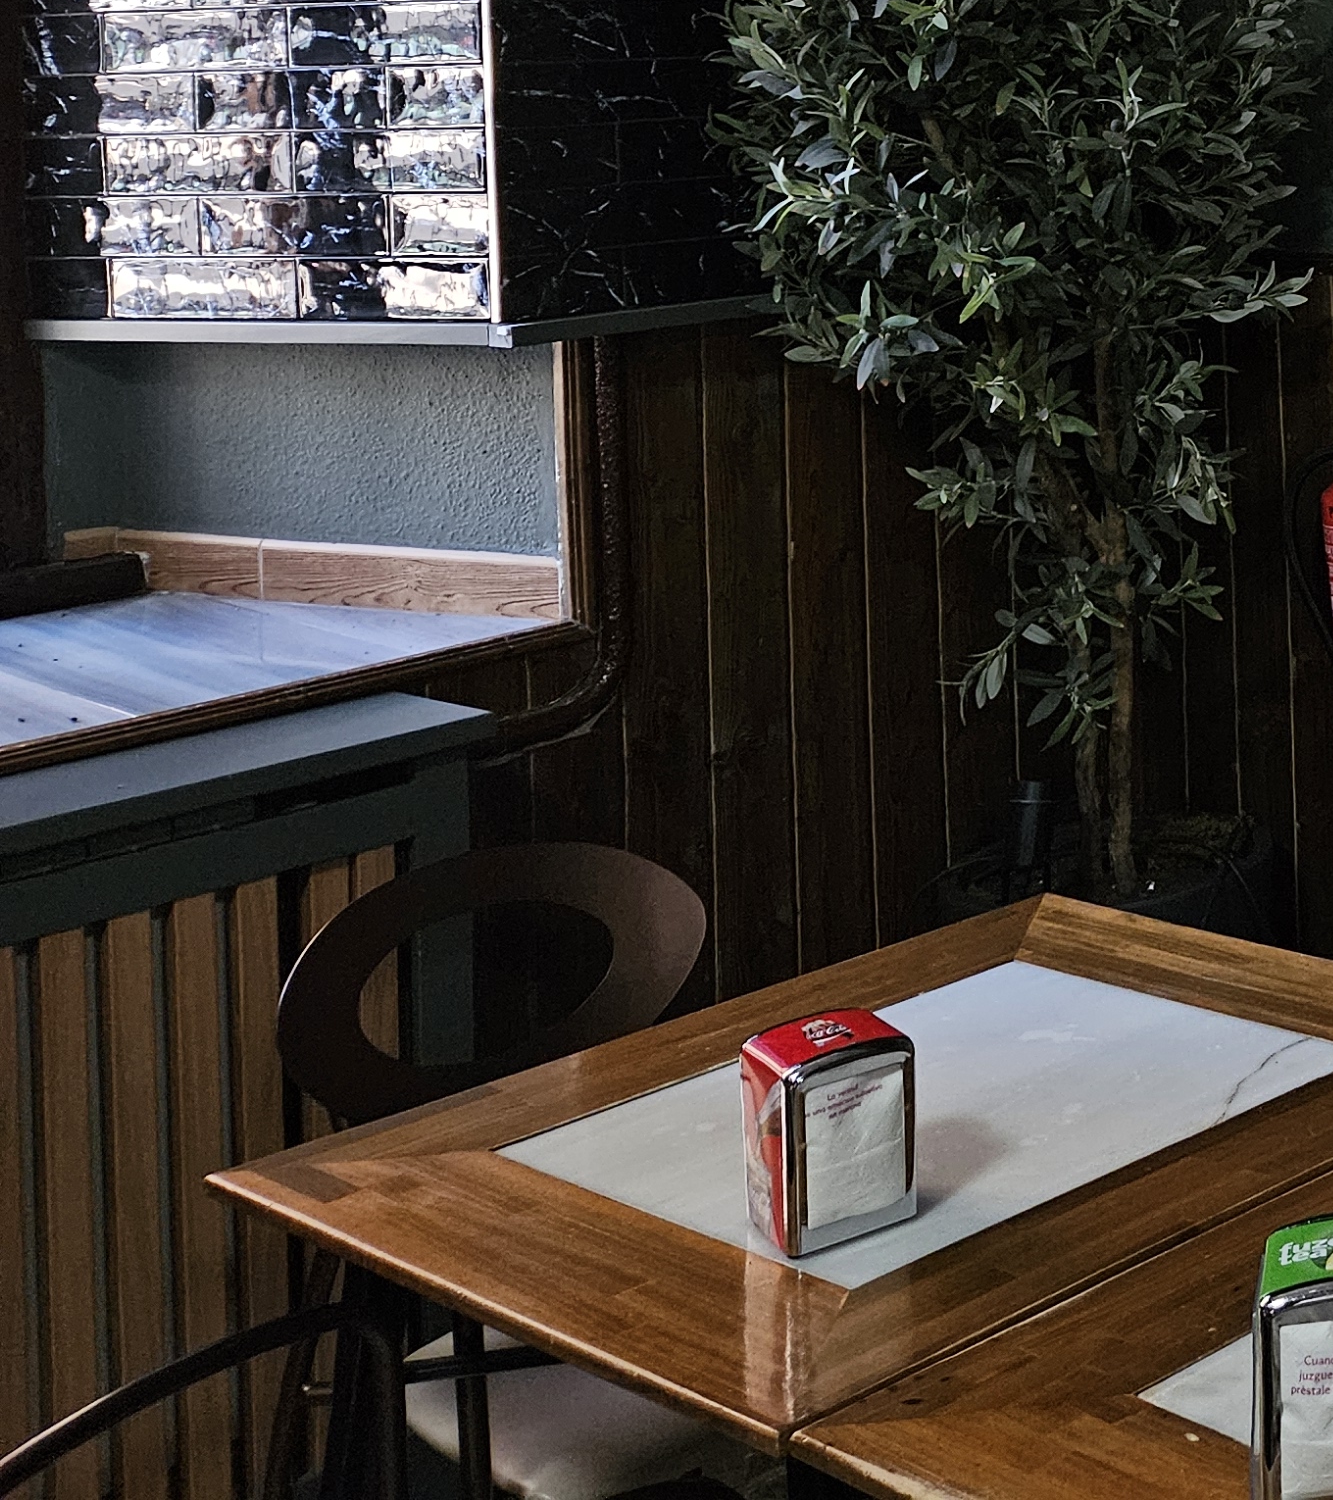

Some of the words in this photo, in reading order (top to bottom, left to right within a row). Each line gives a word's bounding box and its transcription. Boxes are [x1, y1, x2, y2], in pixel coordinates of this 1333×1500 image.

[1278, 1247, 1328, 1266] tea
[1298, 1370, 1333, 1382] juzgue
[1290, 1384, 1331, 1396] préstale
